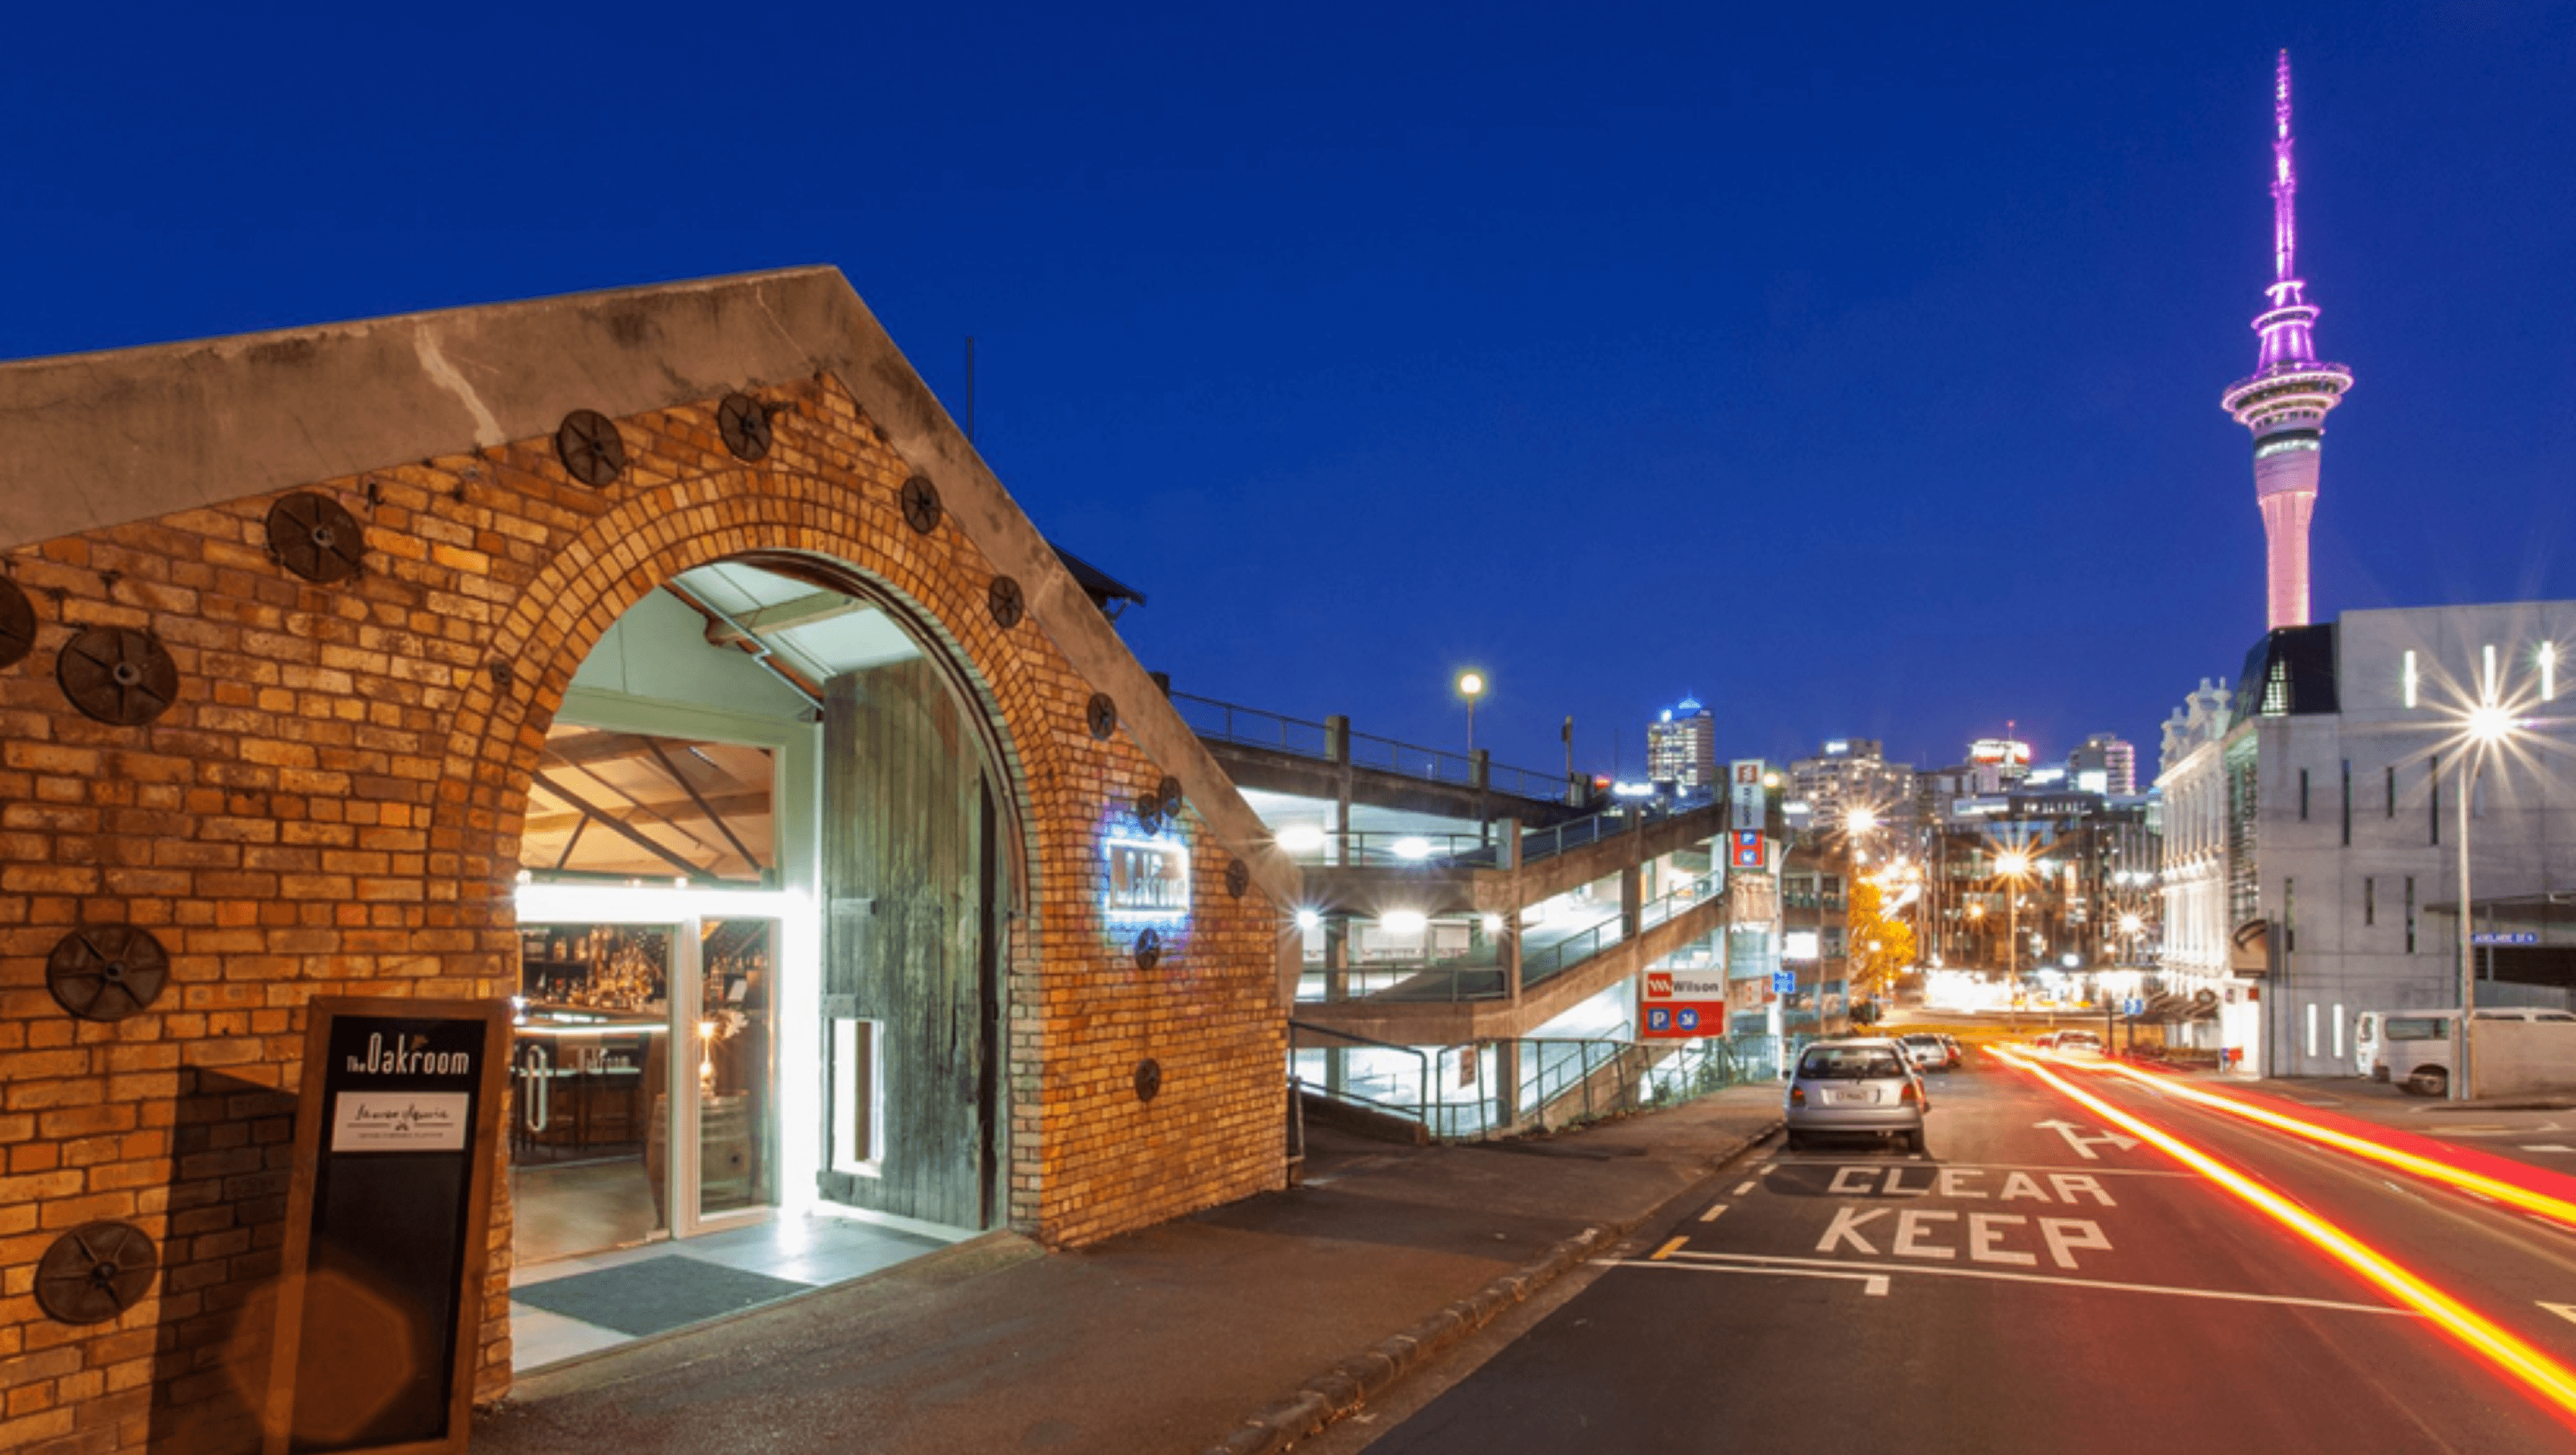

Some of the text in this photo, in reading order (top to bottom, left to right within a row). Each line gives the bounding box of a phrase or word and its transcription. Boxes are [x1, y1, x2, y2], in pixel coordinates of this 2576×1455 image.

[1674, 981, 1719, 992] Wilson
[1653, 1011, 1666, 1027] P
[367, 1031, 470, 1075] Oakroom
[1827, 1165, 2118, 1207] CLEAR
[1814, 1206, 2114, 1270] KEEP
